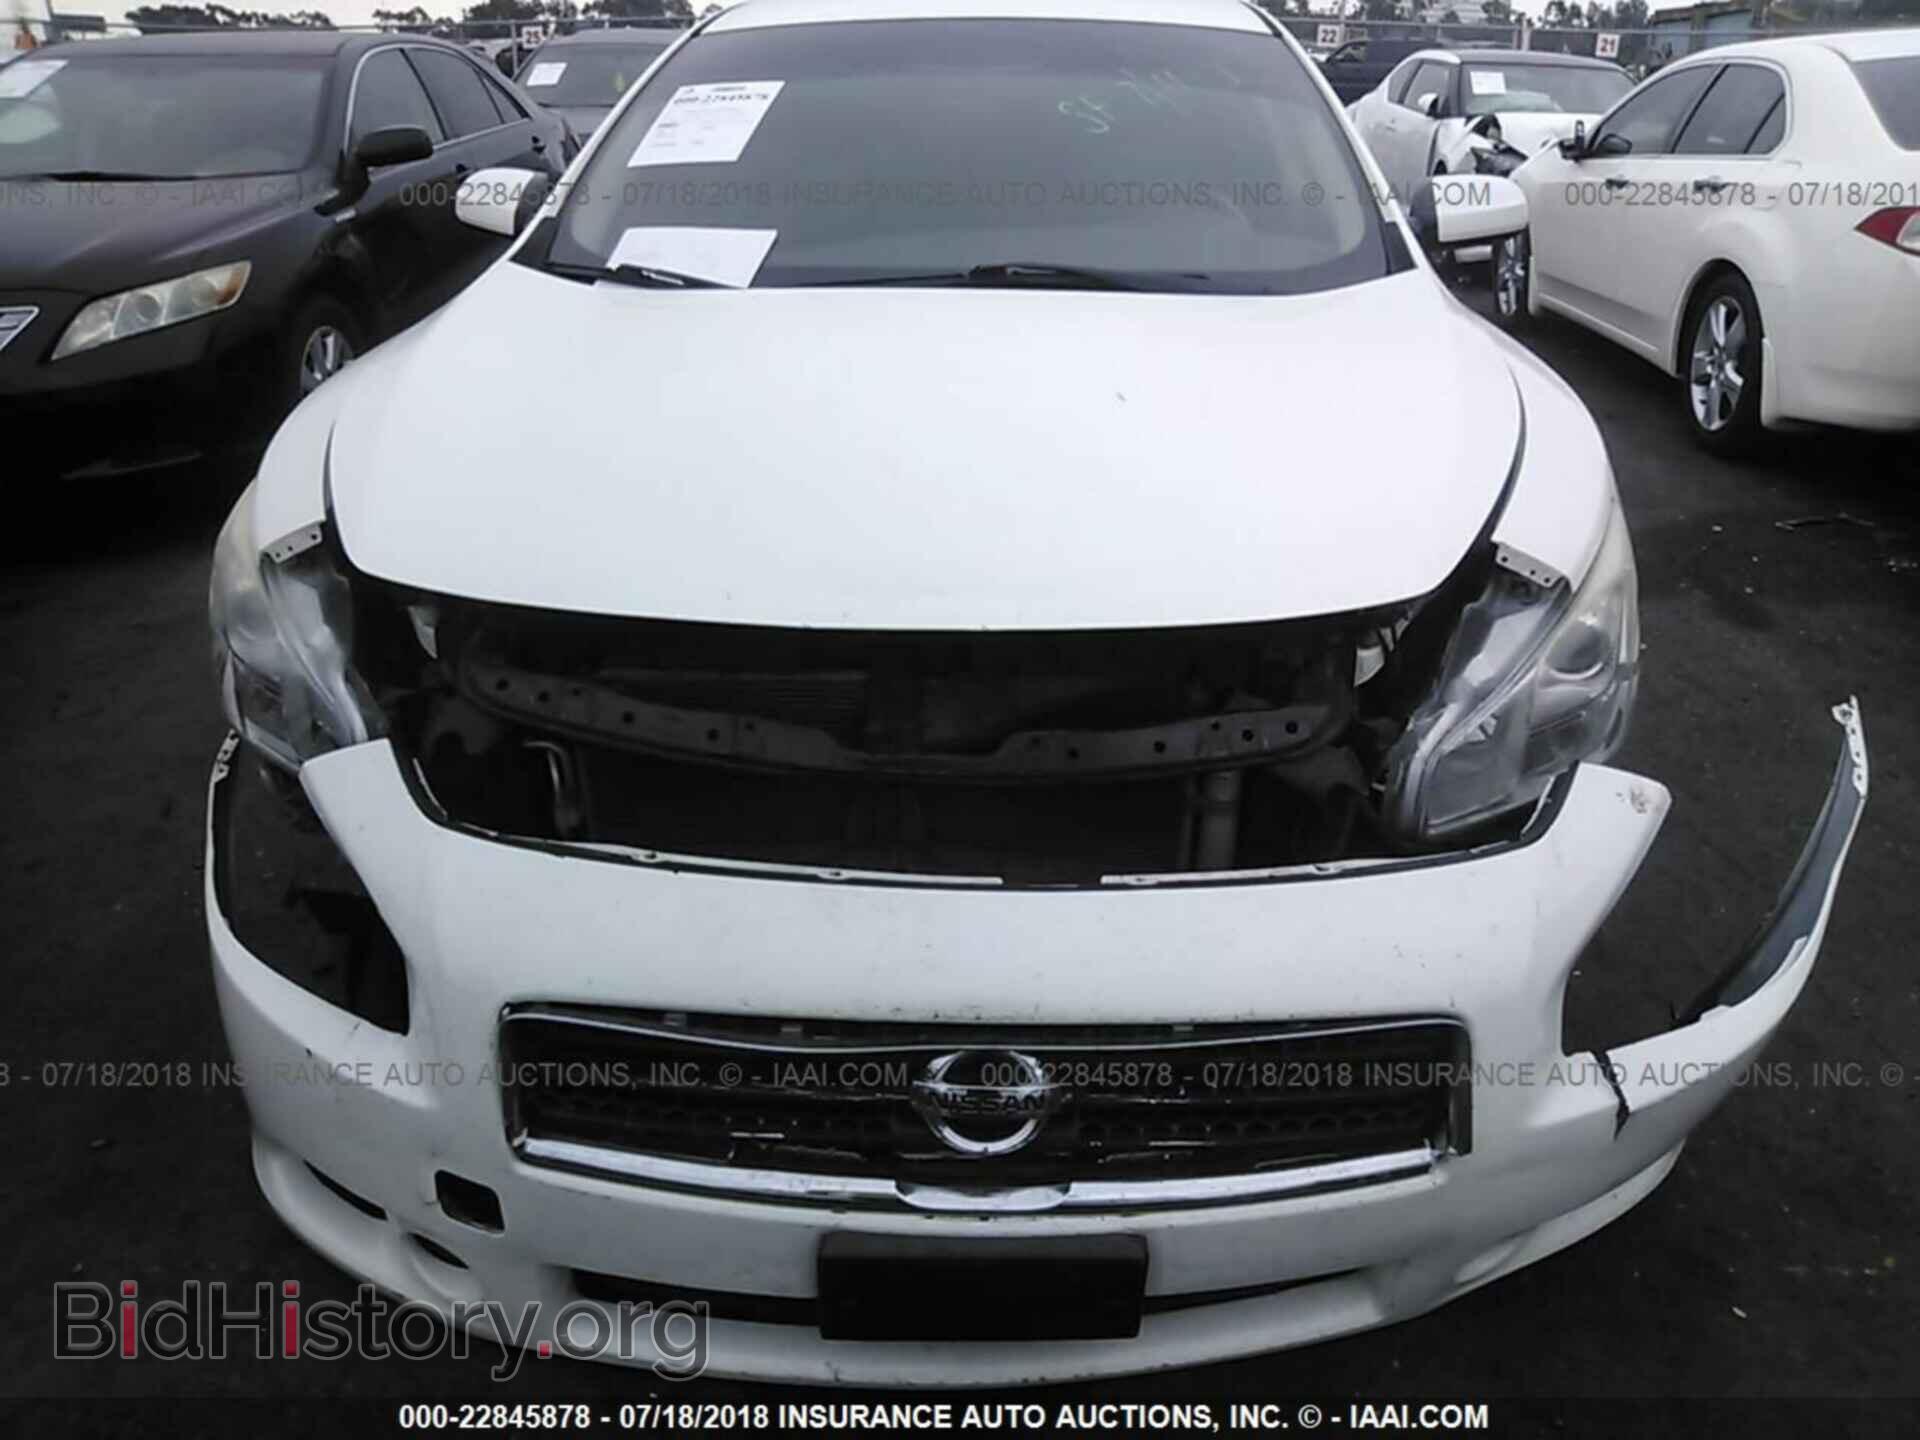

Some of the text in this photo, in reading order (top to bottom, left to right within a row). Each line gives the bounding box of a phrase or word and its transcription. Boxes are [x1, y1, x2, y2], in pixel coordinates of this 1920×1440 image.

[1321, 28, 1338, 43] 22
[1600, 37, 1617, 53] 21
[926, 1089, 1046, 1112] NISSAN
